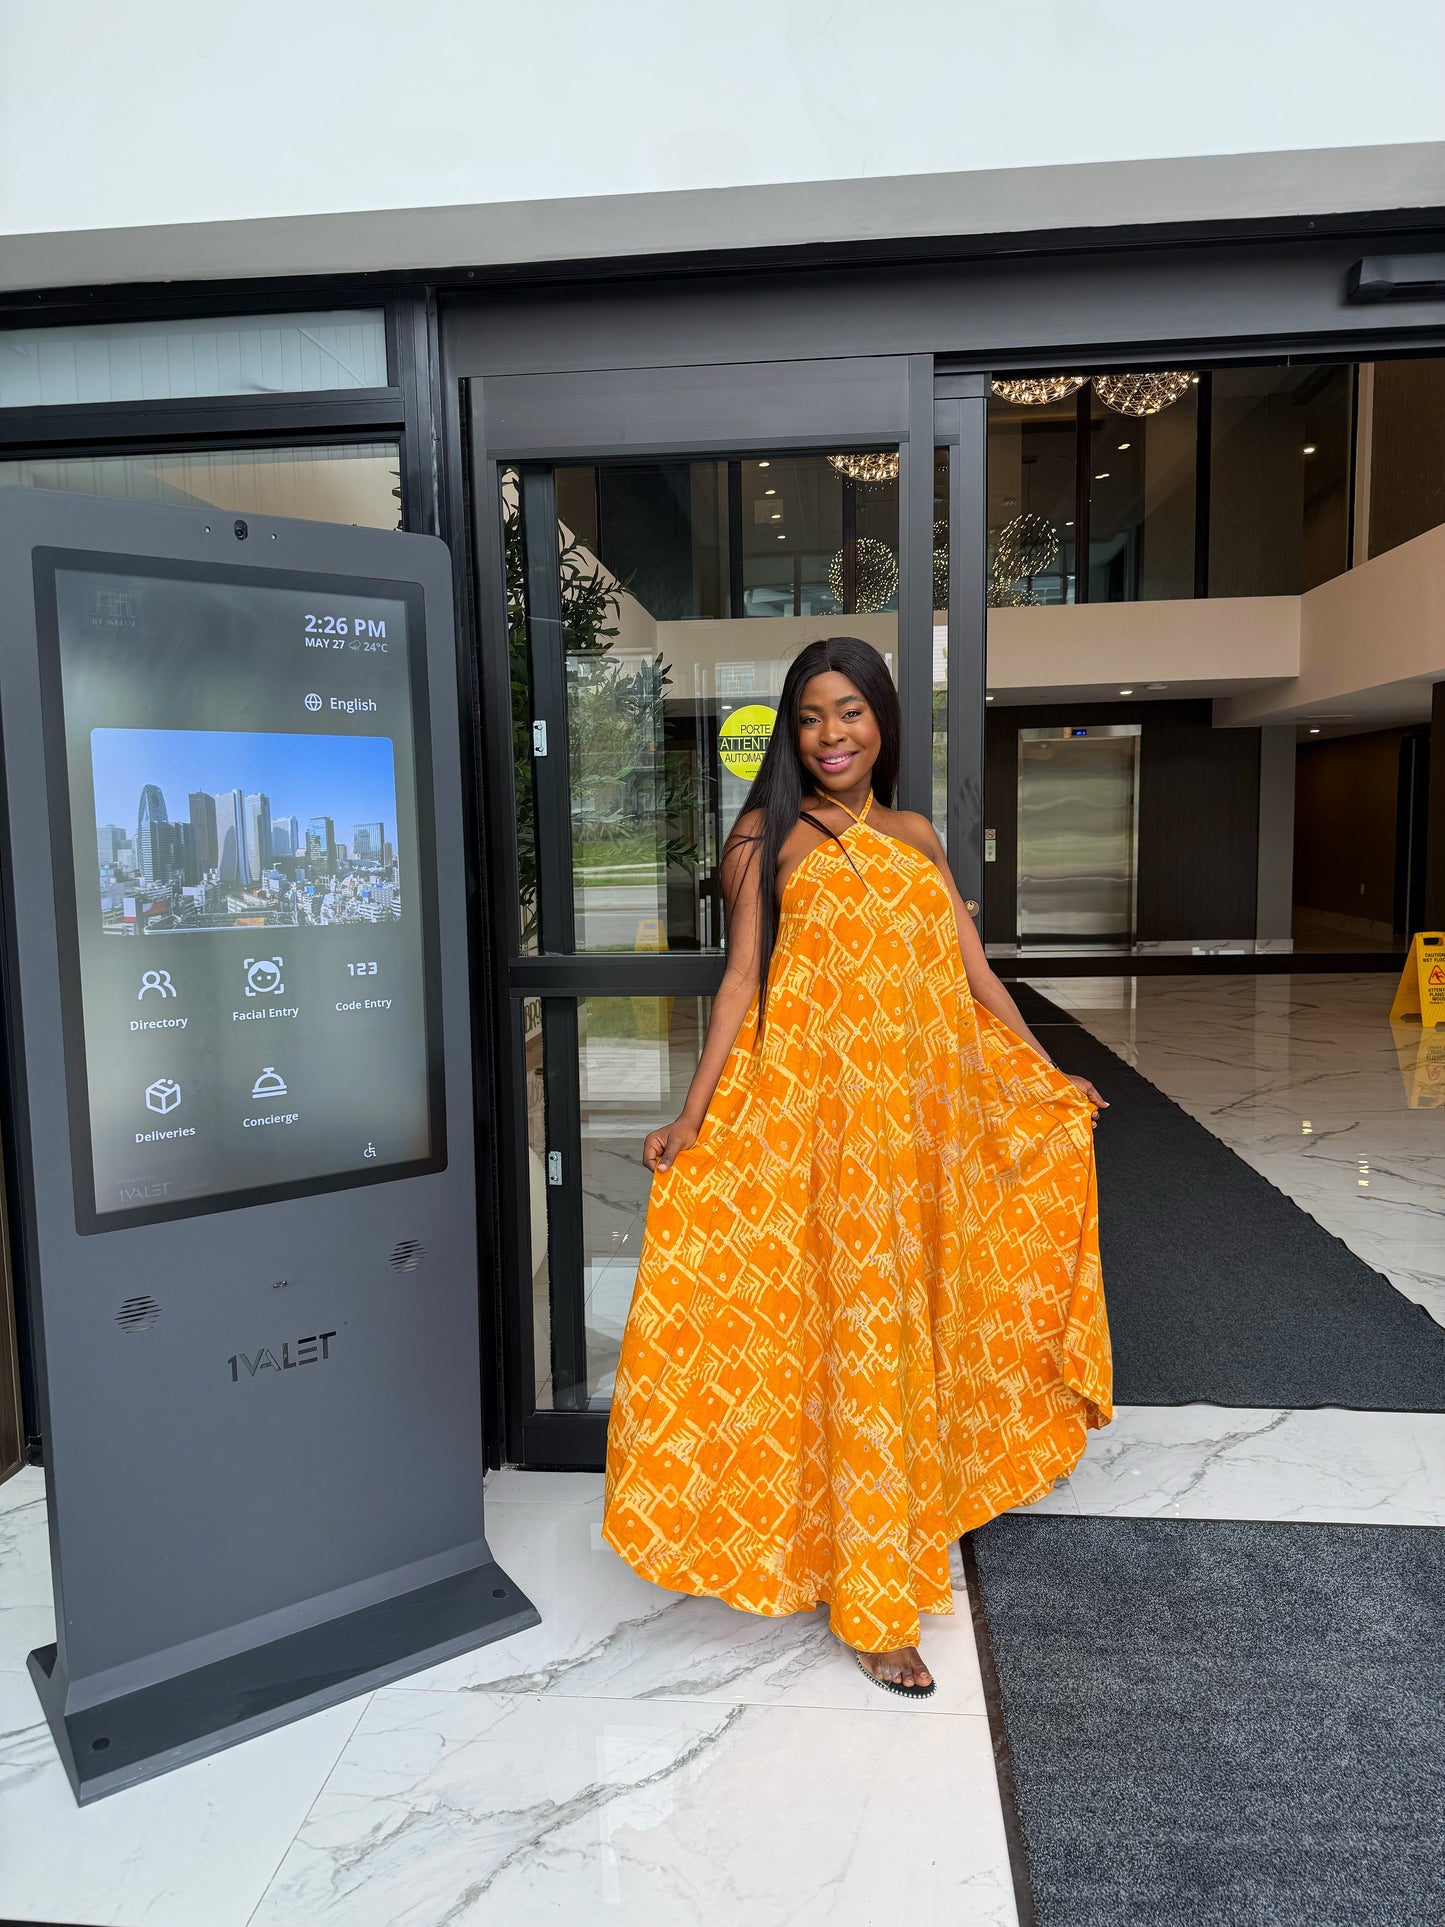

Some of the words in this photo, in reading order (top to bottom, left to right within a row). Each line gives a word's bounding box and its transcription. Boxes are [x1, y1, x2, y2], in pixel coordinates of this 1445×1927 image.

[304, 614, 348, 635] 2:26
[354, 618, 386, 638] PM
[305, 637, 330, 648] MAY
[332, 639, 345, 649] 27
[363, 641, 388, 653] 24°C
[330, 697, 377, 713] English
[740, 724, 771, 734] PORTE
[720, 737, 771, 750] ATTENT
[347, 961, 378, 977] 123
[335, 1001, 362, 1011] Code
[364, 999, 392, 1009] Entry
[232, 1009, 266, 1021] Facial
[269, 1007, 299, 1018] Entry
[130, 1018, 188, 1031] Directory
[243, 1112, 299, 1128] Concierge
[135, 1127, 196, 1143] Deliveries
[227, 1331, 337, 1382] 1VALET
